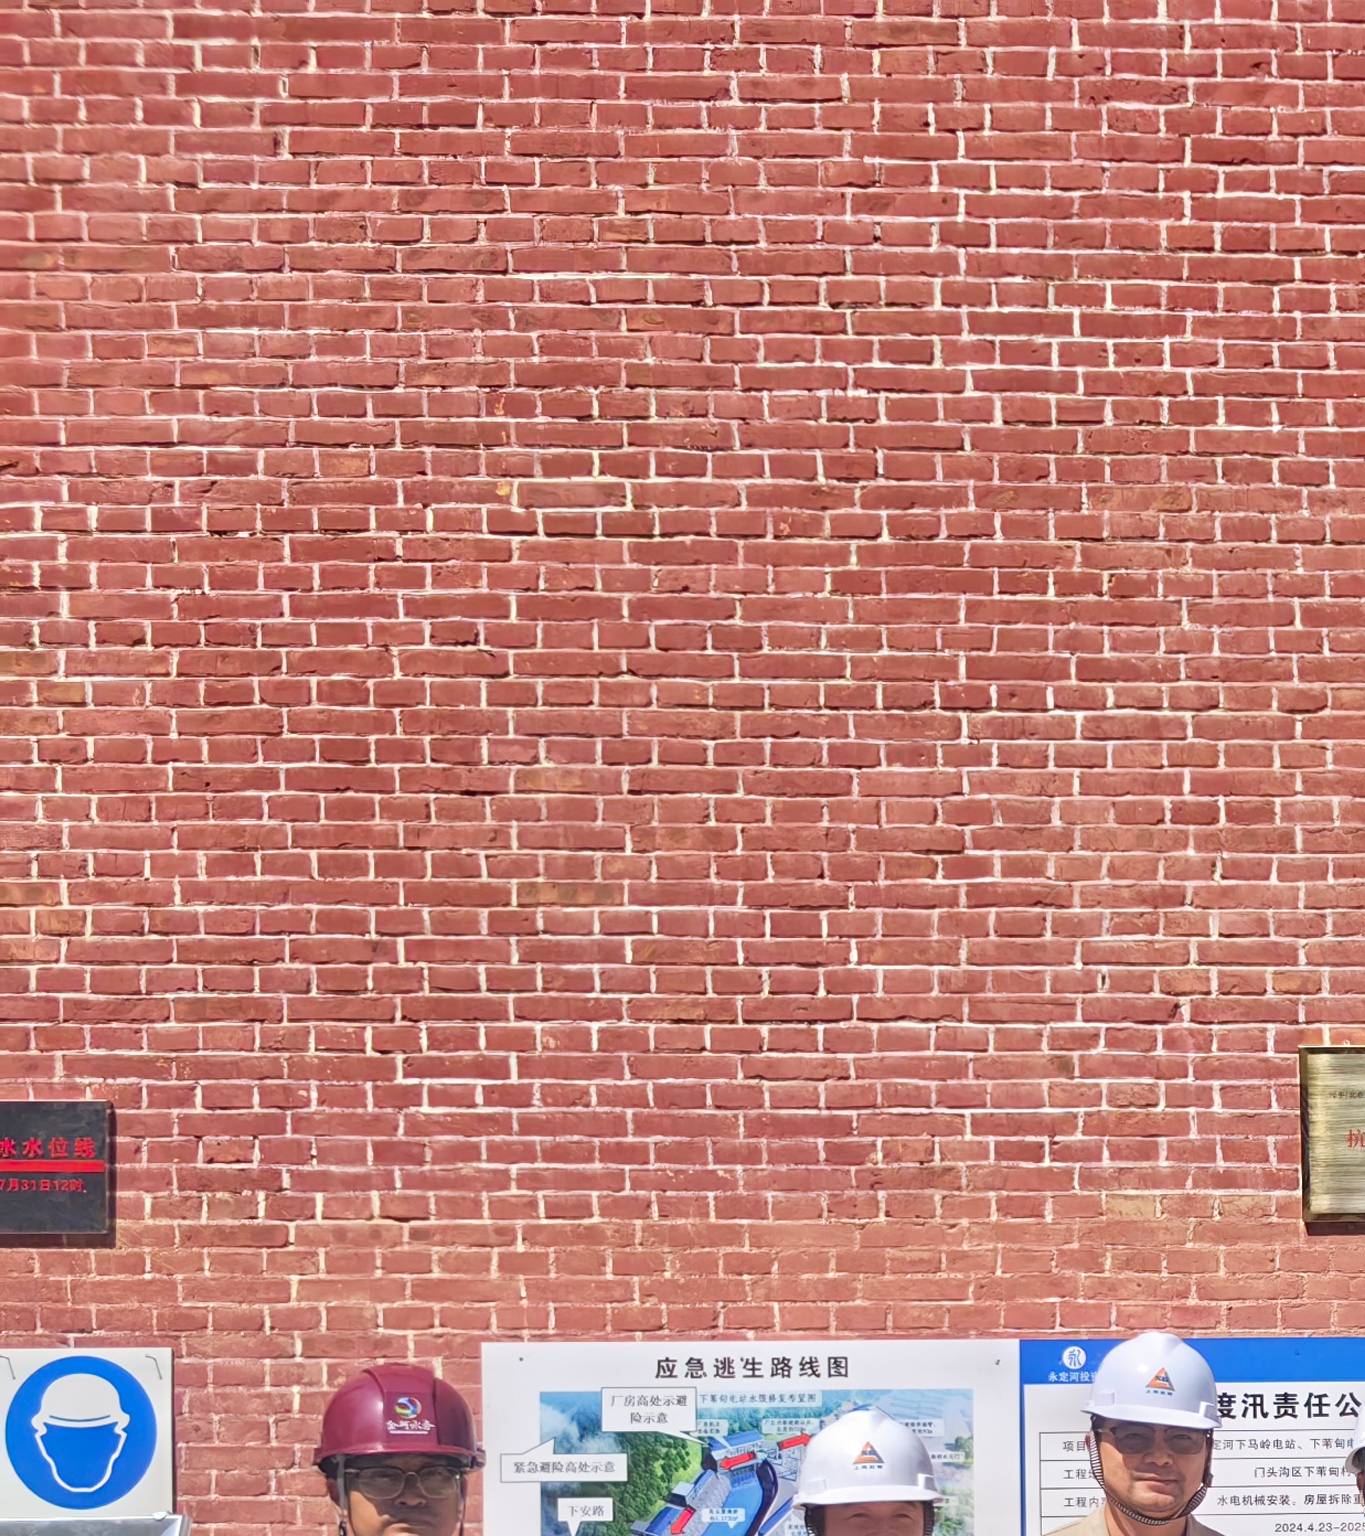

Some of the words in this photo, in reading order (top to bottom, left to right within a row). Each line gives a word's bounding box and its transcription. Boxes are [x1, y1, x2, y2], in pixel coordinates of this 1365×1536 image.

[655, 1356, 849, 1379] 应急逃生路线图
[611, 1394, 688, 1408] 厂房高处示避
[1217, 1392, 1362, 1419] 度汛责任公
[630, 1411, 668, 1424] 险示意
[513, 1461, 616, 1474] 紧急避险高处示意
[568, 1505, 605, 1518] 下安路
